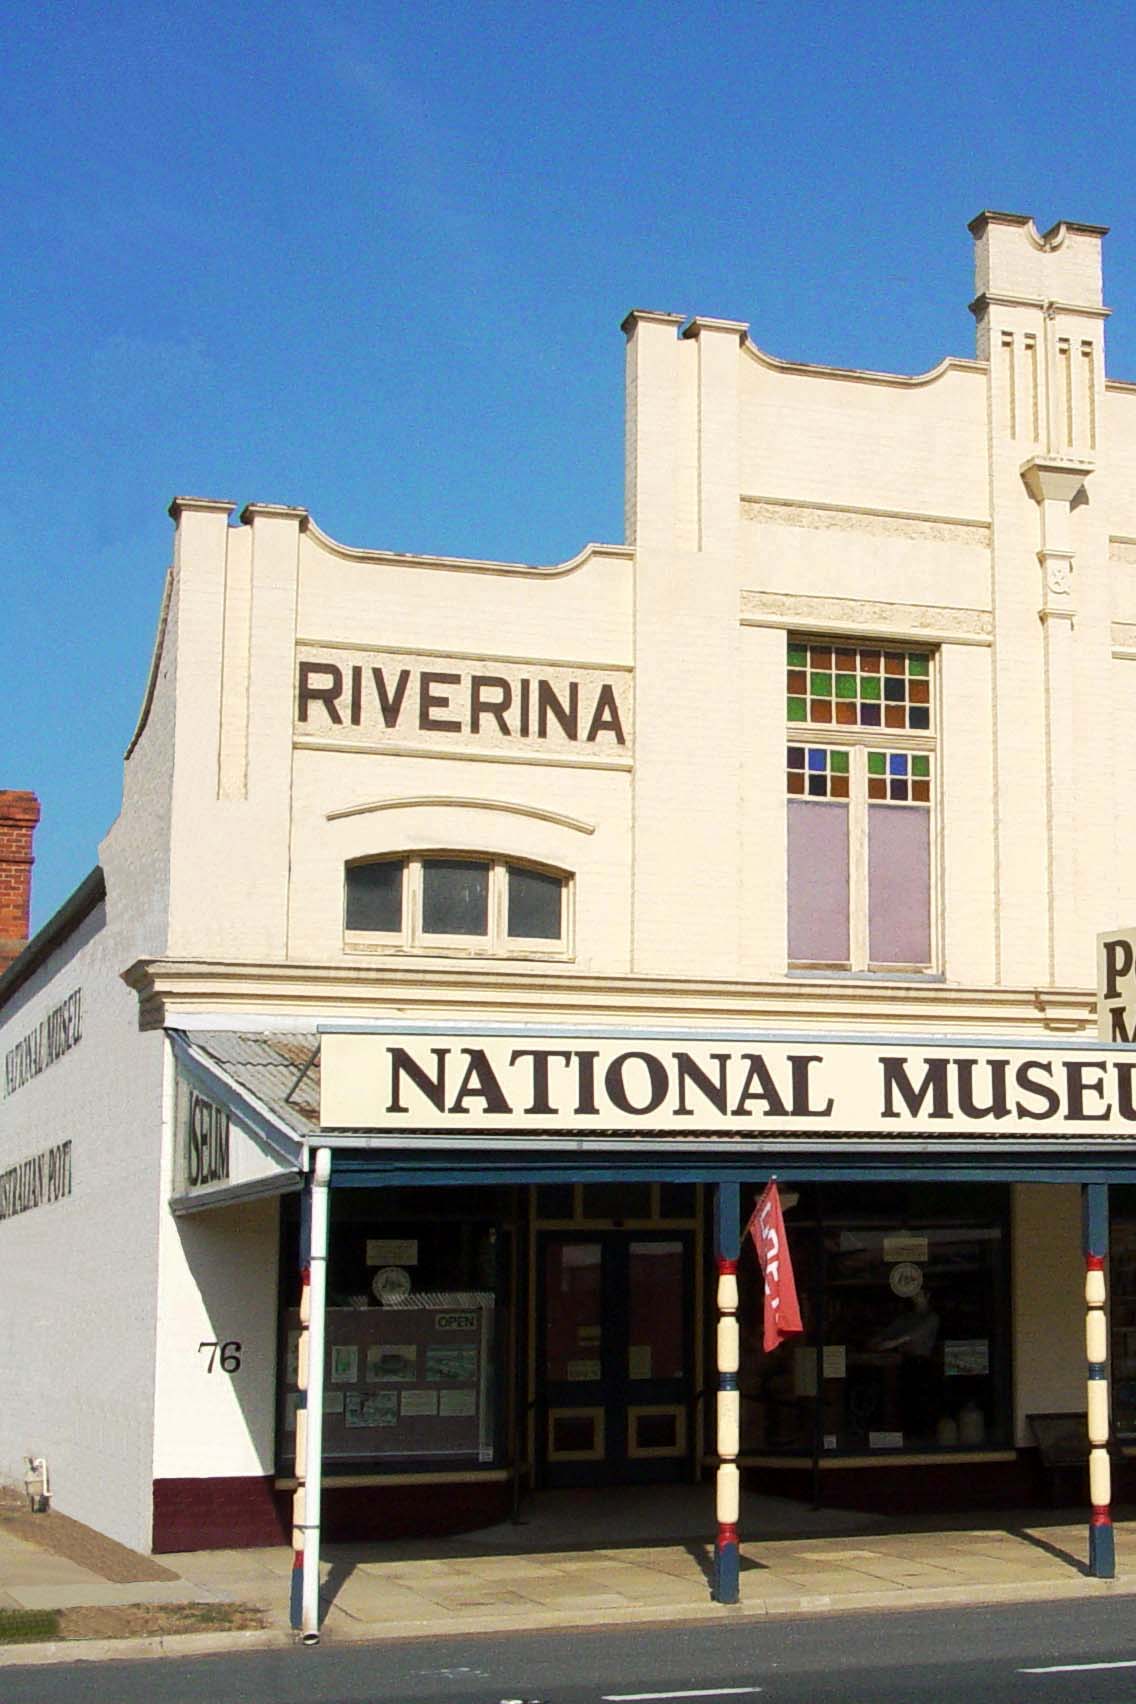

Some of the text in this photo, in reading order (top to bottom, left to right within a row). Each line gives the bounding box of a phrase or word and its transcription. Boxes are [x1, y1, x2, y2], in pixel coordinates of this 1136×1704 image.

[297, 660, 626, 746] RIVERINA
[385, 1046, 835, 1118] NATIONAL
[437, 1315, 476, 1329] OPEN
[197, 1340, 242, 1374] 76
